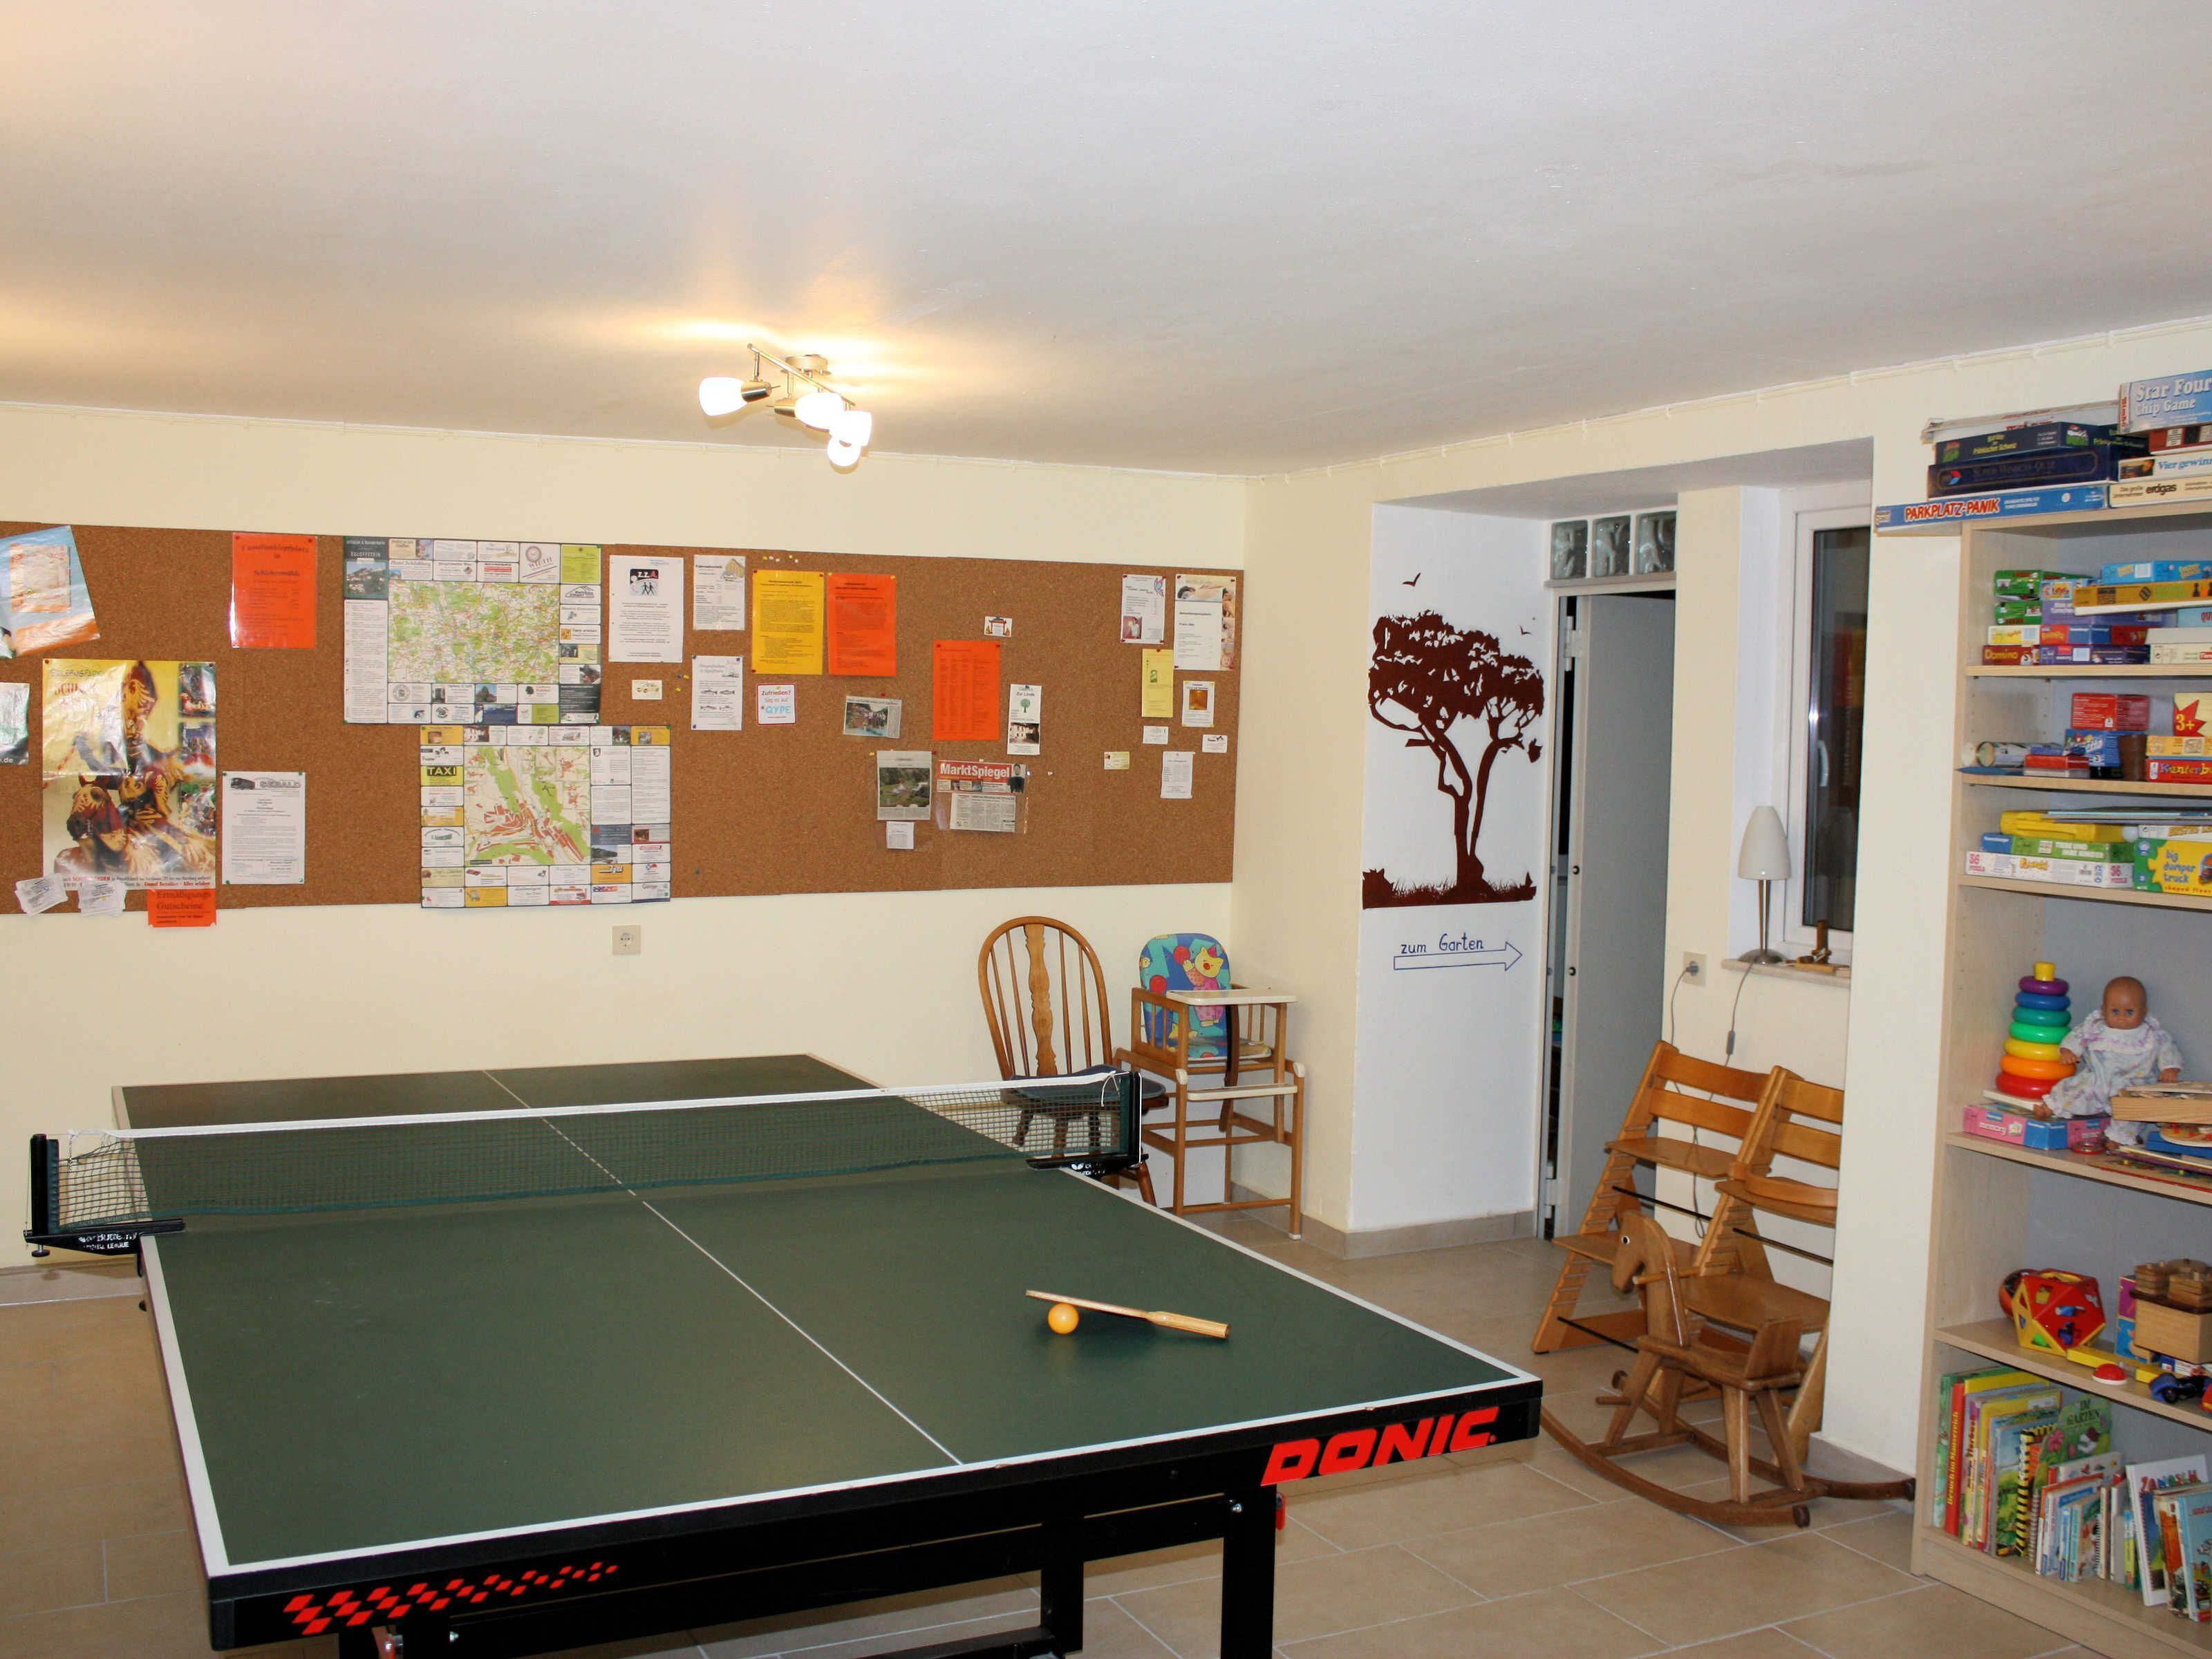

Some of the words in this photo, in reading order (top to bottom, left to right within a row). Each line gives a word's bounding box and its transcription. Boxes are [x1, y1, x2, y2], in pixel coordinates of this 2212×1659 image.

[2136, 385, 2169, 402] Star
[2173, 377, 2212, 397] Four
[2137, 402, 2160, 418] Chip
[2164, 399, 2196, 413] Game
[2146, 484, 2177, 495] erdgas
[1905, 497, 2000, 522] PARKPLATZ-PANIK
[1985, 648, 2018, 659] Domino
[765, 706, 791, 714] QYPE
[2176, 714, 2195, 731] 3+
[940, 763, 1010, 779] MarktSpiegel
[2166, 850, 2178, 863] big
[2164, 862, 2195, 874] dumper
[2164, 873, 2188, 883] truck
[1401, 944, 1427, 954] zum
[1439, 932, 1484, 952] Garten
[1260, 1406, 1499, 1487] DONIC
